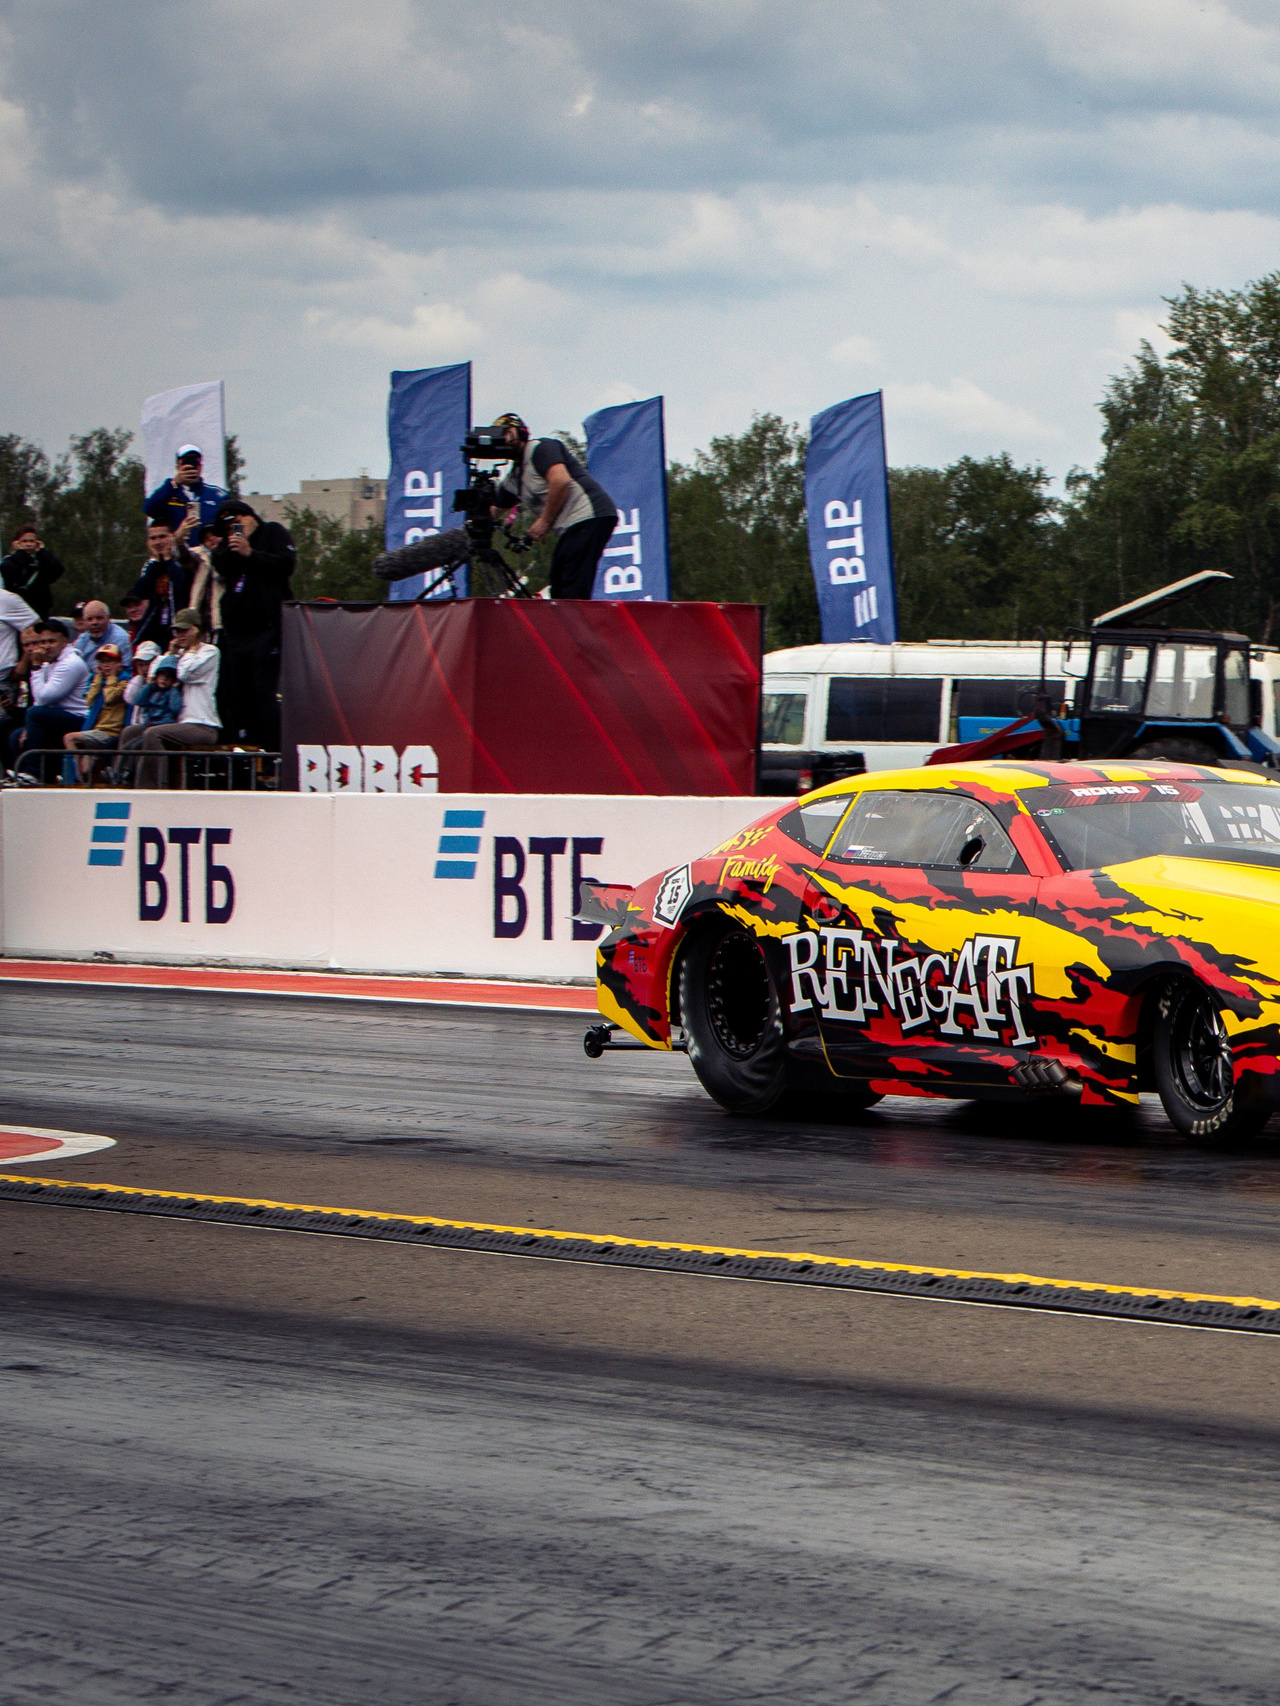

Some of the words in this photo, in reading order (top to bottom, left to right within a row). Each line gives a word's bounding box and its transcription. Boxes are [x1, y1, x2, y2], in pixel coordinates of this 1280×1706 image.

[1150, 783, 1181, 797] 15
[137, 826, 236, 925] ВТБ
[492, 836, 607, 942] ВТБ
[719, 854, 783, 894] Family
[667, 885, 682, 905] 15
